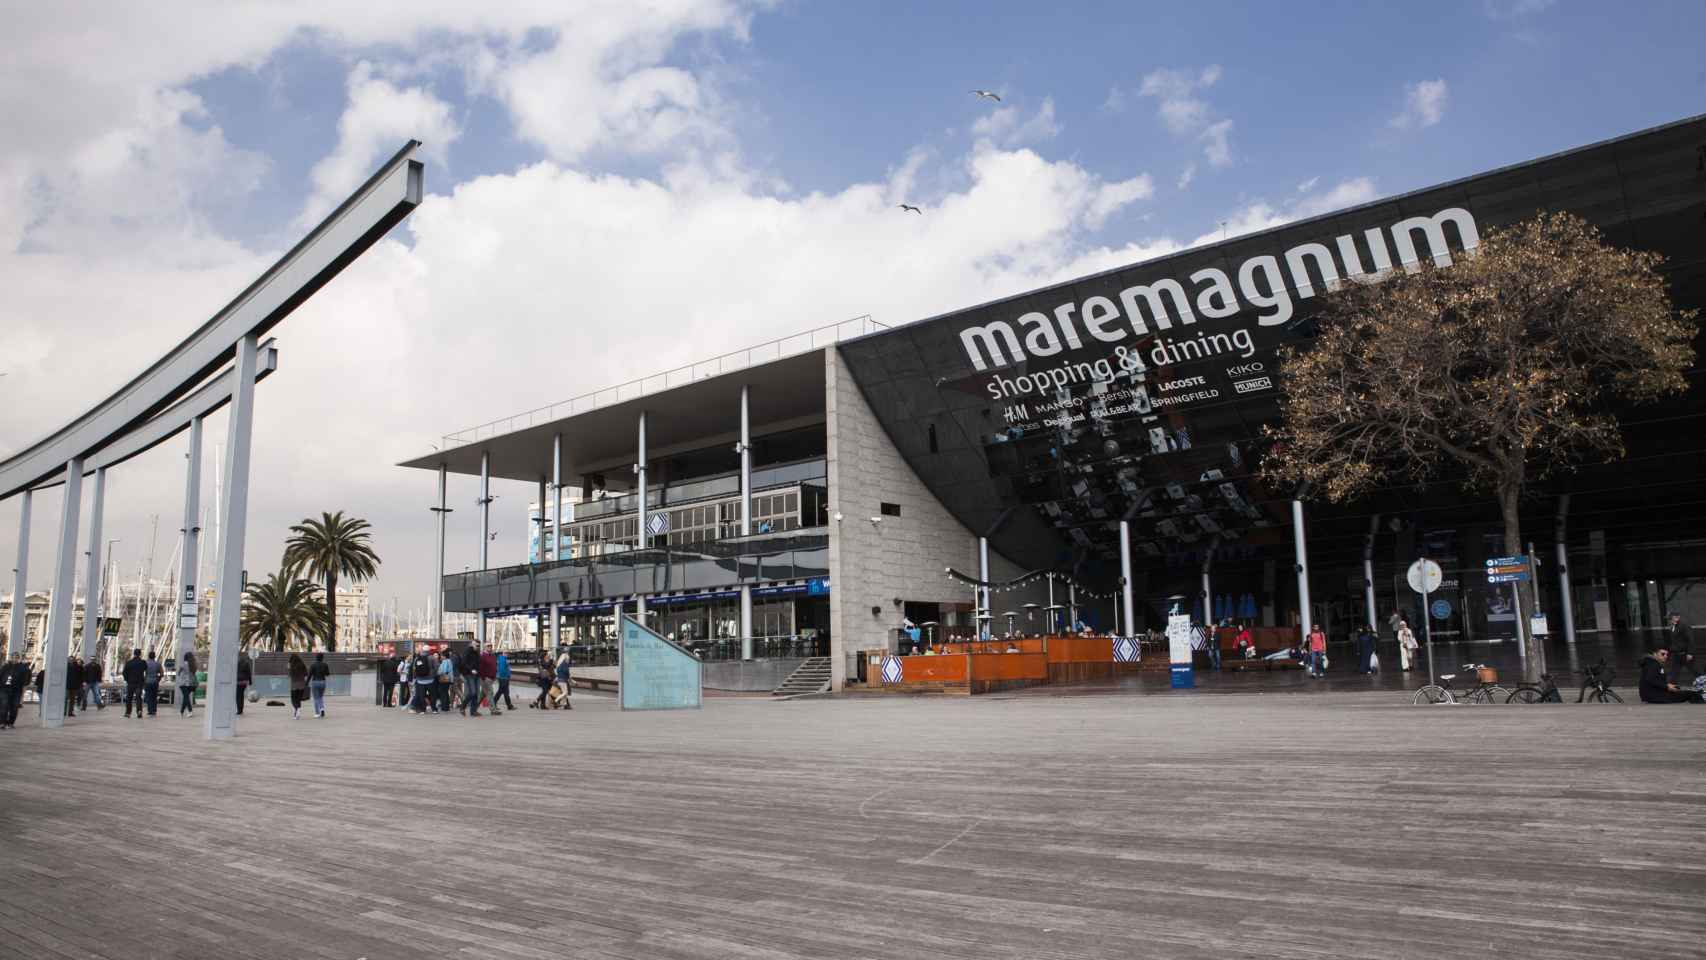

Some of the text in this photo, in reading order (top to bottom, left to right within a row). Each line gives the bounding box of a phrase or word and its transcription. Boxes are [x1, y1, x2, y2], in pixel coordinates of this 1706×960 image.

[959, 206, 1480, 371] maremagnum
[987, 329, 1255, 400] shopping & dining
[1226, 361, 1264, 376] KIKO
[1158, 376, 1206, 391] LACOSTE
[1236, 379, 1271, 392] MUNICH
[1035, 397, 1083, 413] MANGO
[1151, 389, 1219, 408] SPRINGFIELD
[1003, 403, 1029, 423] H&M
